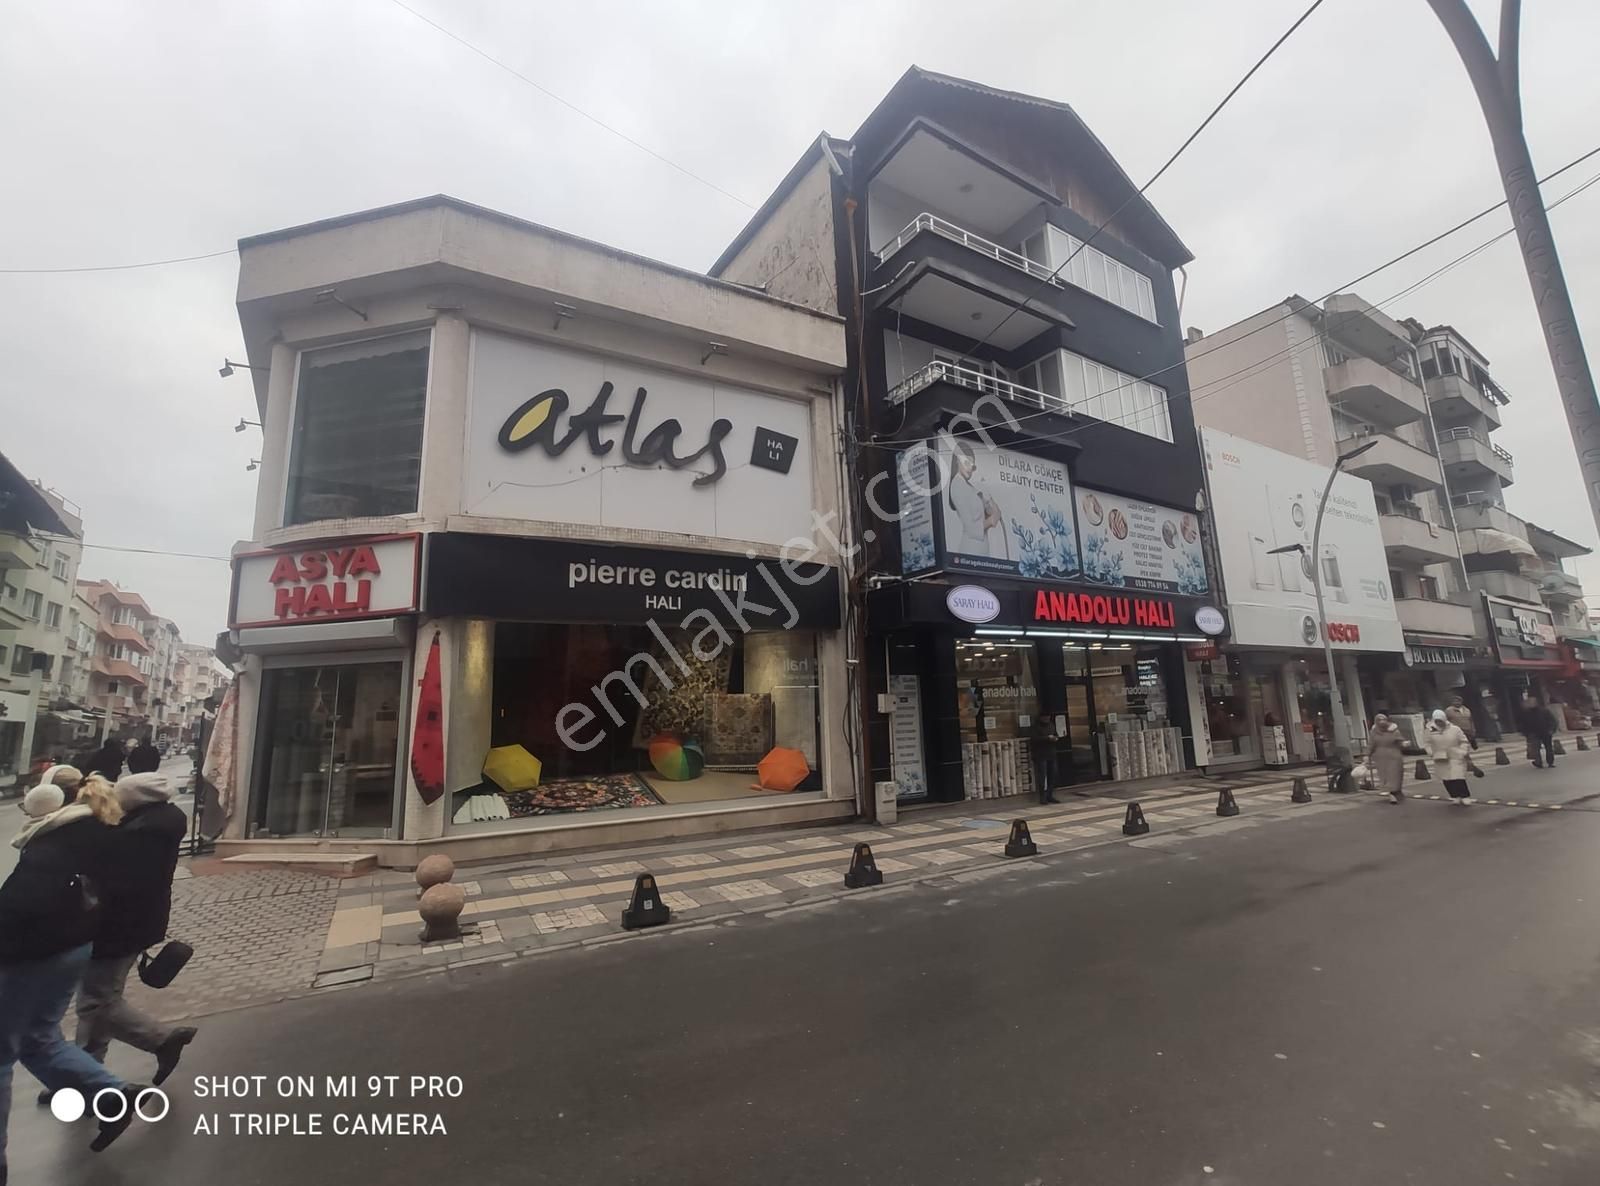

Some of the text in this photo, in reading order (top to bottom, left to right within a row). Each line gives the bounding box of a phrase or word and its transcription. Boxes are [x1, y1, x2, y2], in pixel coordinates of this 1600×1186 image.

[498, 380, 733, 489] atlas
[767, 439, 783, 451] HA
[1000, 471, 1065, 495] BEAUTY CENTER
[268, 545, 382, 585] ASYA
[568, 557, 748, 592] pierre cardin
[273, 579, 372, 618] HALI
[645, 594, 681, 610] HALI
[953, 597, 975, 609] SARAY
[1034, 589, 1176, 628] ANADOLU HALI
[982, 686, 1019, 698] anadolu
